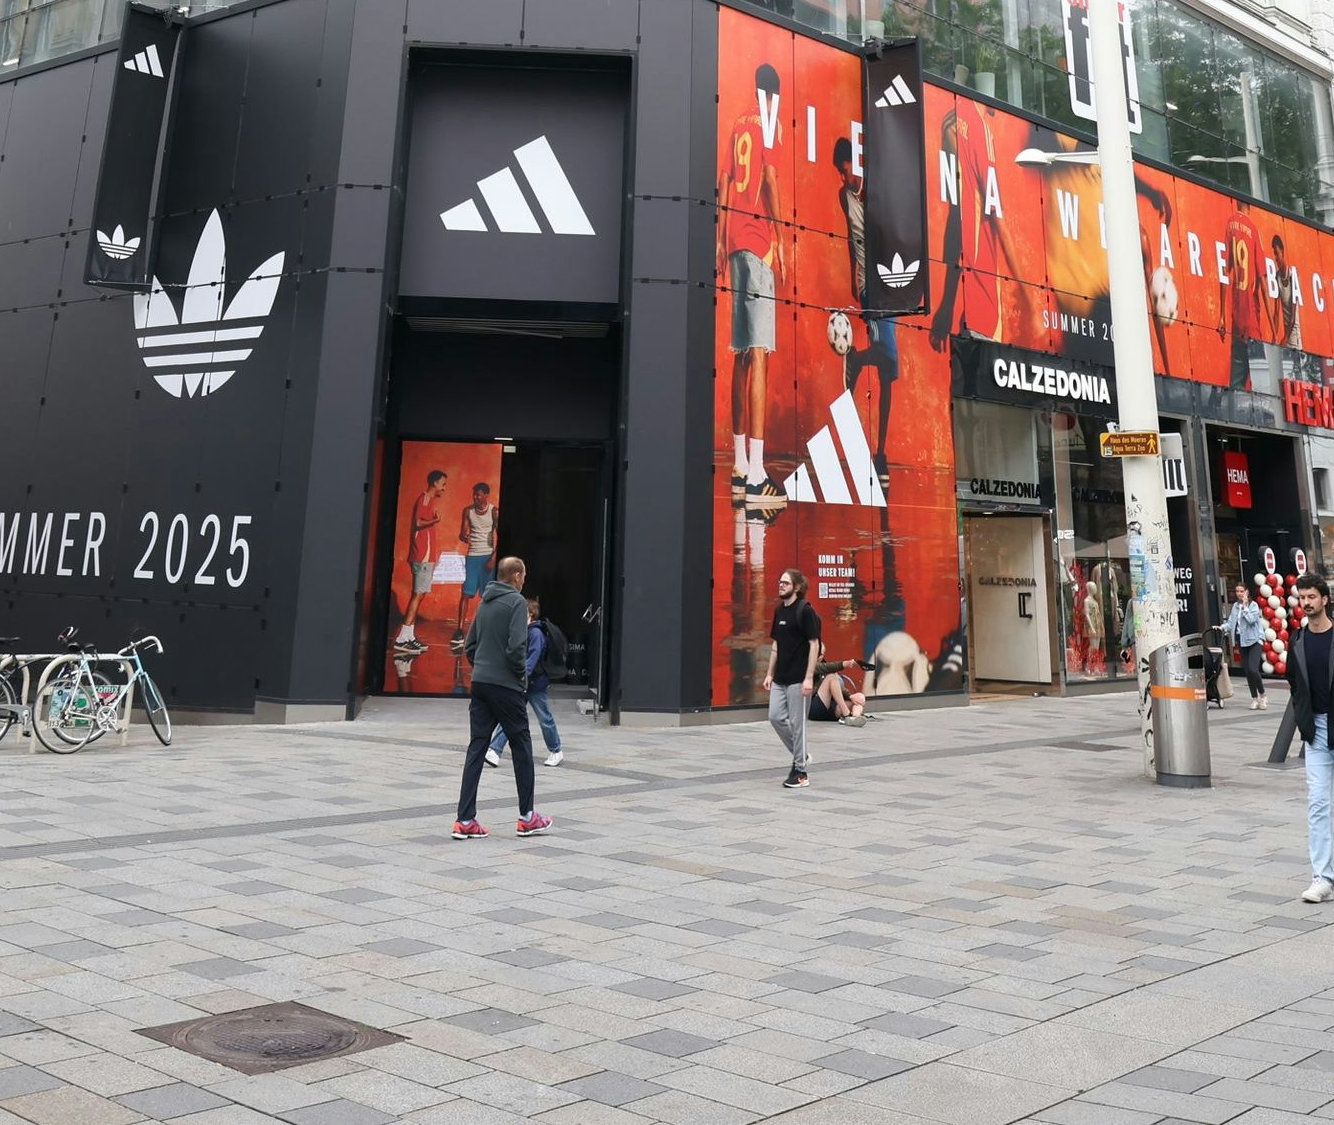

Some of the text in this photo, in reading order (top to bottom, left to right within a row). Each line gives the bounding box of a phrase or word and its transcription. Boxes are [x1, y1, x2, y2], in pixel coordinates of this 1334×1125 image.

[757, 88, 1003, 219] VIENA
[1160, 223, 1229, 286] ARE
[1232, 236, 1249, 291] 19
[1042, 309, 1095, 338] SUMMER
[993, 358, 1111, 405] CALZEDONIA
[970, 478, 1042, 499] CALZEDONIA
[1227, 468, 1249, 485] HEMA
[133, 510, 252, 588] 2025
[818, 567, 856, 577] UNSER TEAM!
